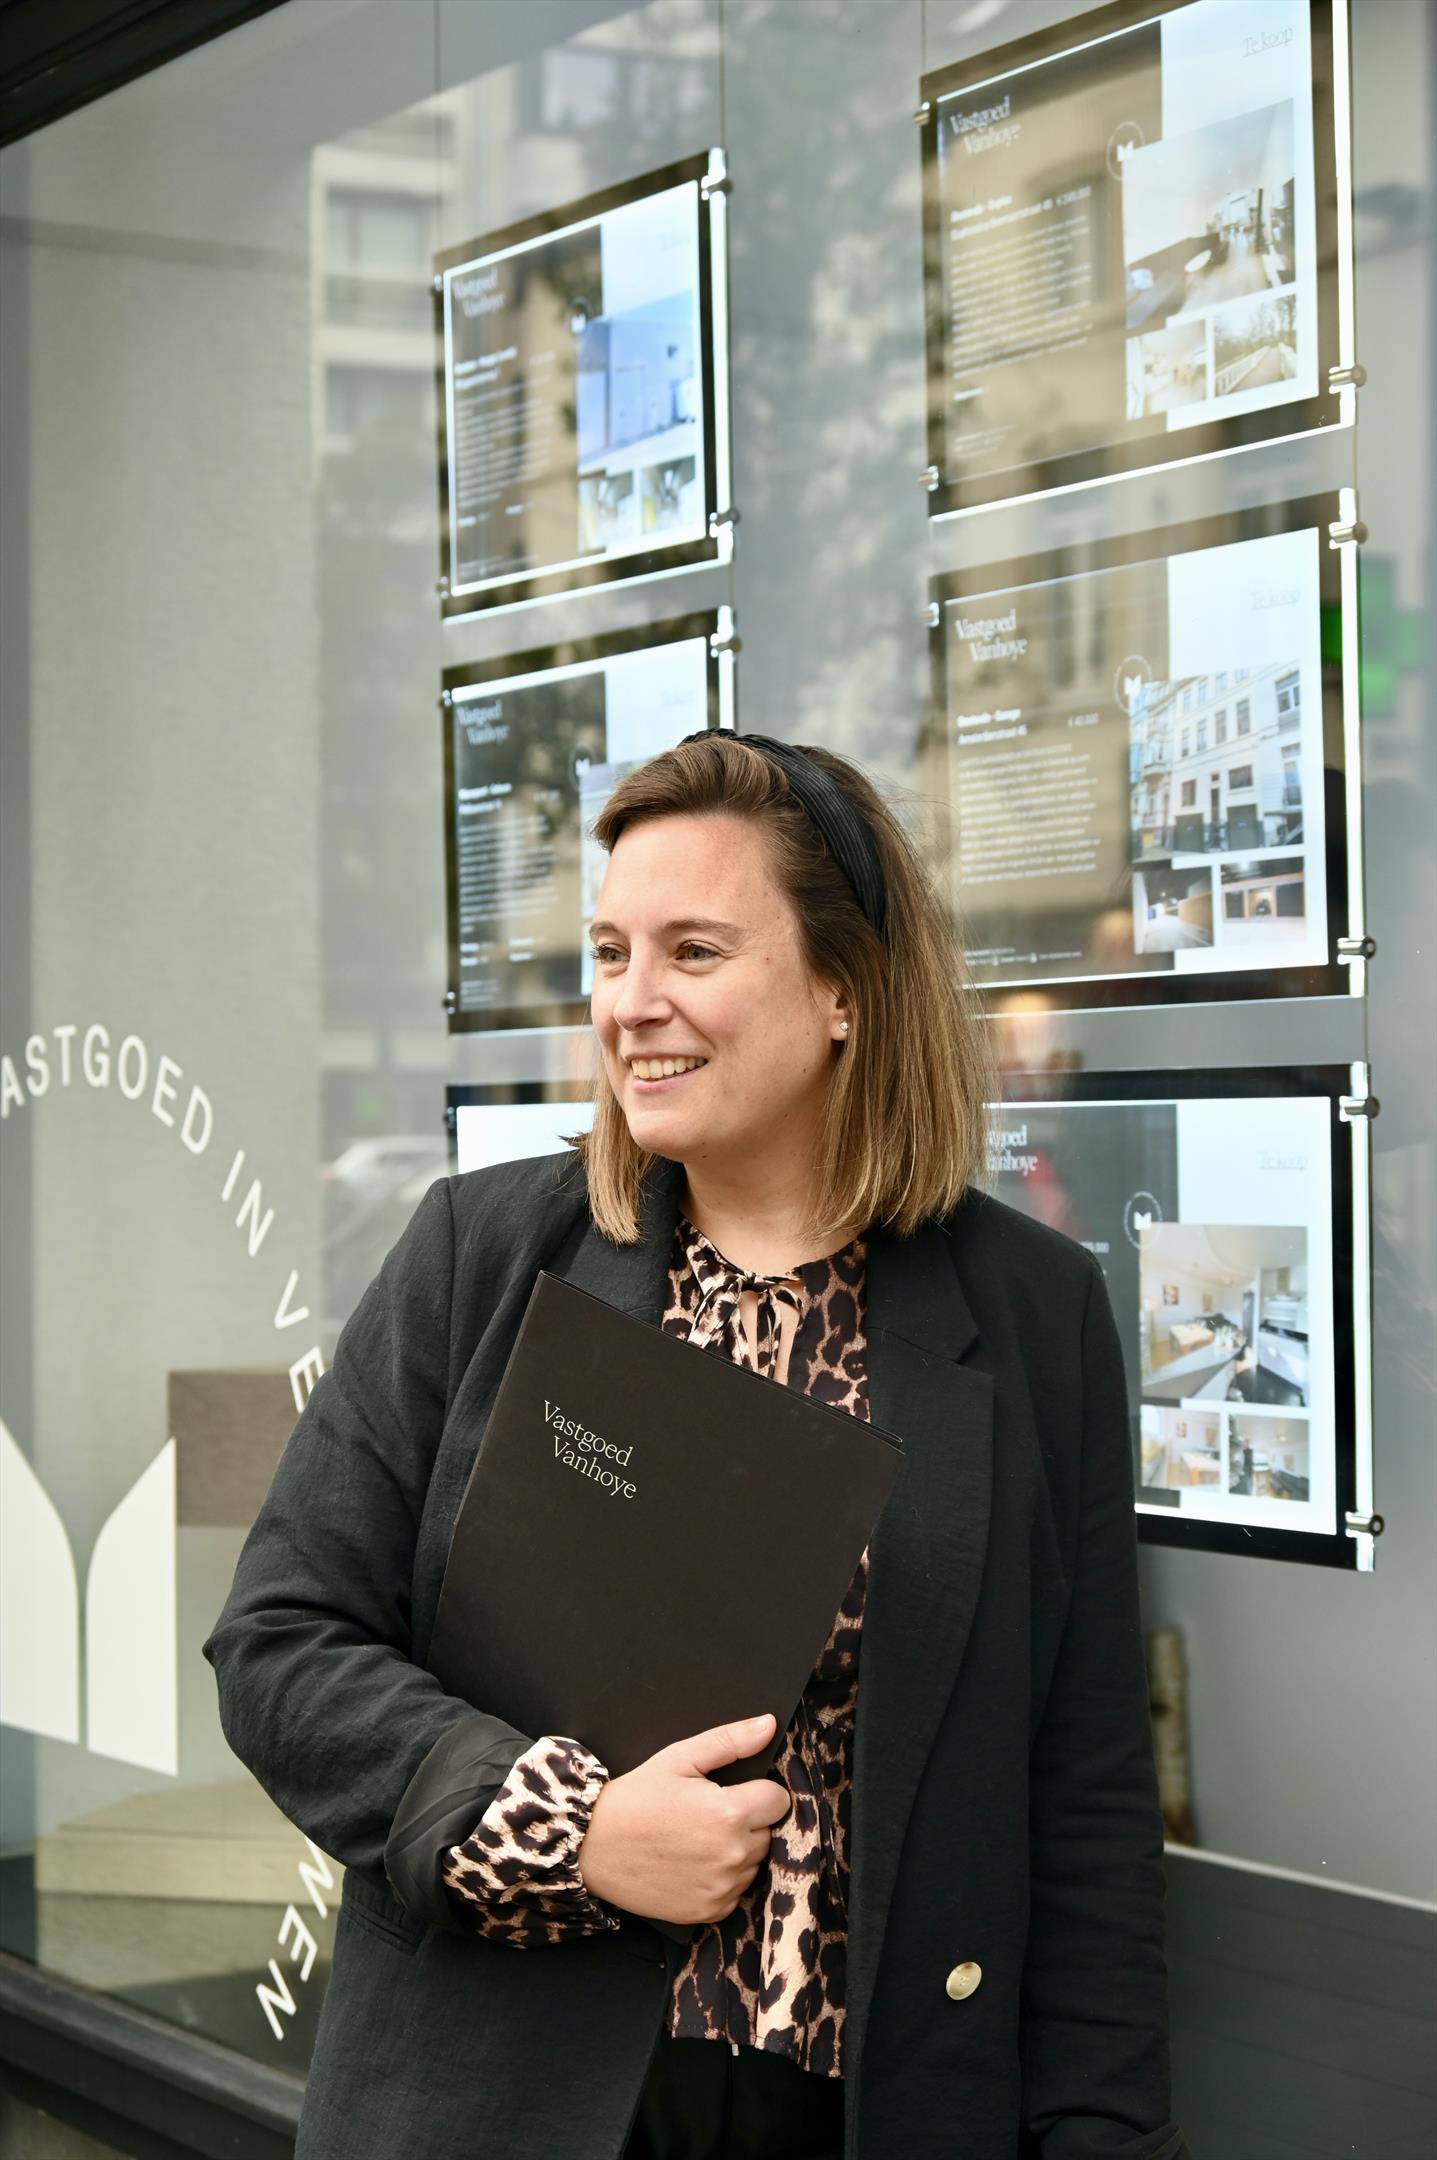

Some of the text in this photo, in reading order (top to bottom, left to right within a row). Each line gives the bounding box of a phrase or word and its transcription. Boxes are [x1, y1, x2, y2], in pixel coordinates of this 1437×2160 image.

[0, 1024, 325, 1414] ASTGOED IN VE
[544, 1399, 633, 1467] Vastgoed
[554, 1435, 637, 1499] Vanhoye
